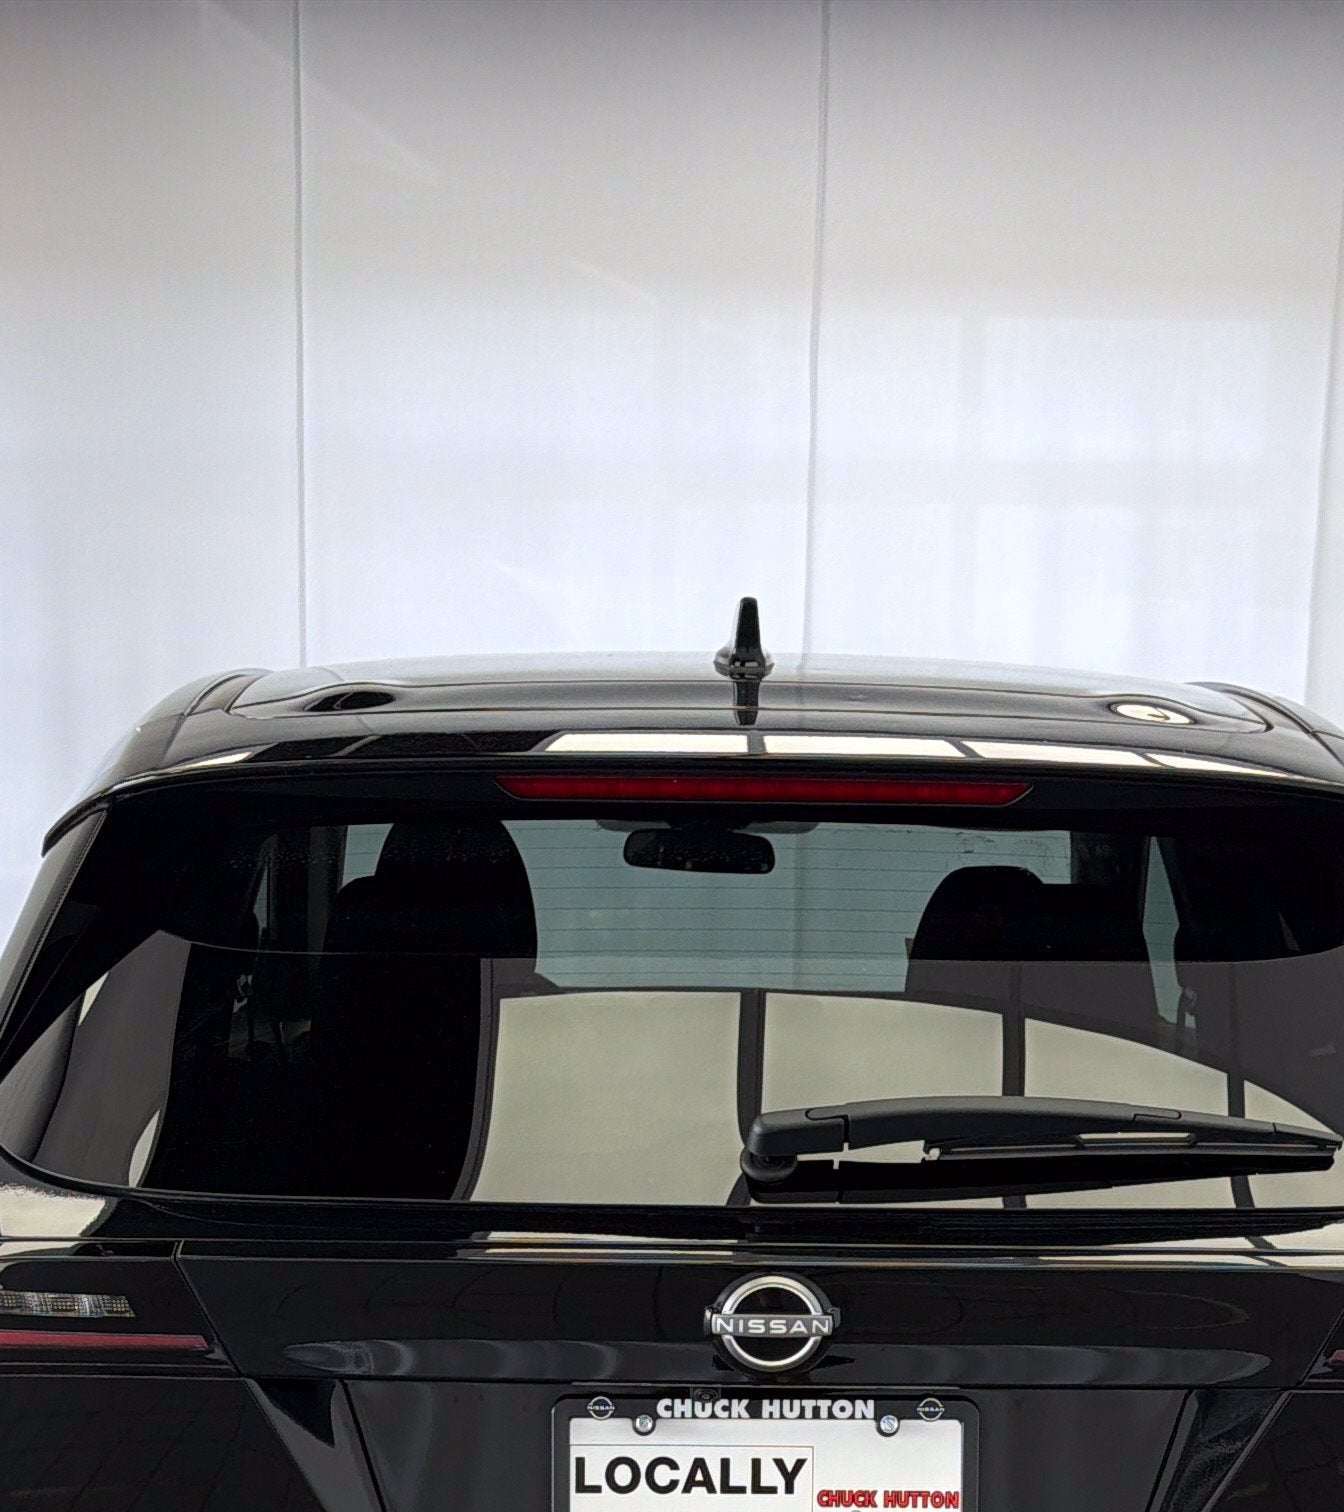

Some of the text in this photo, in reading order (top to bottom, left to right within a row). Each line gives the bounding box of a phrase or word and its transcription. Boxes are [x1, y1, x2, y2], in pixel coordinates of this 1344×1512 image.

[717, 1317, 829, 1334] NISSAN
[657, 1398, 875, 1419] CHUCK HUTTON
[575, 1457, 807, 1494] LOCALLY
[817, 1490, 959, 1509] CHUCK HUTTON
